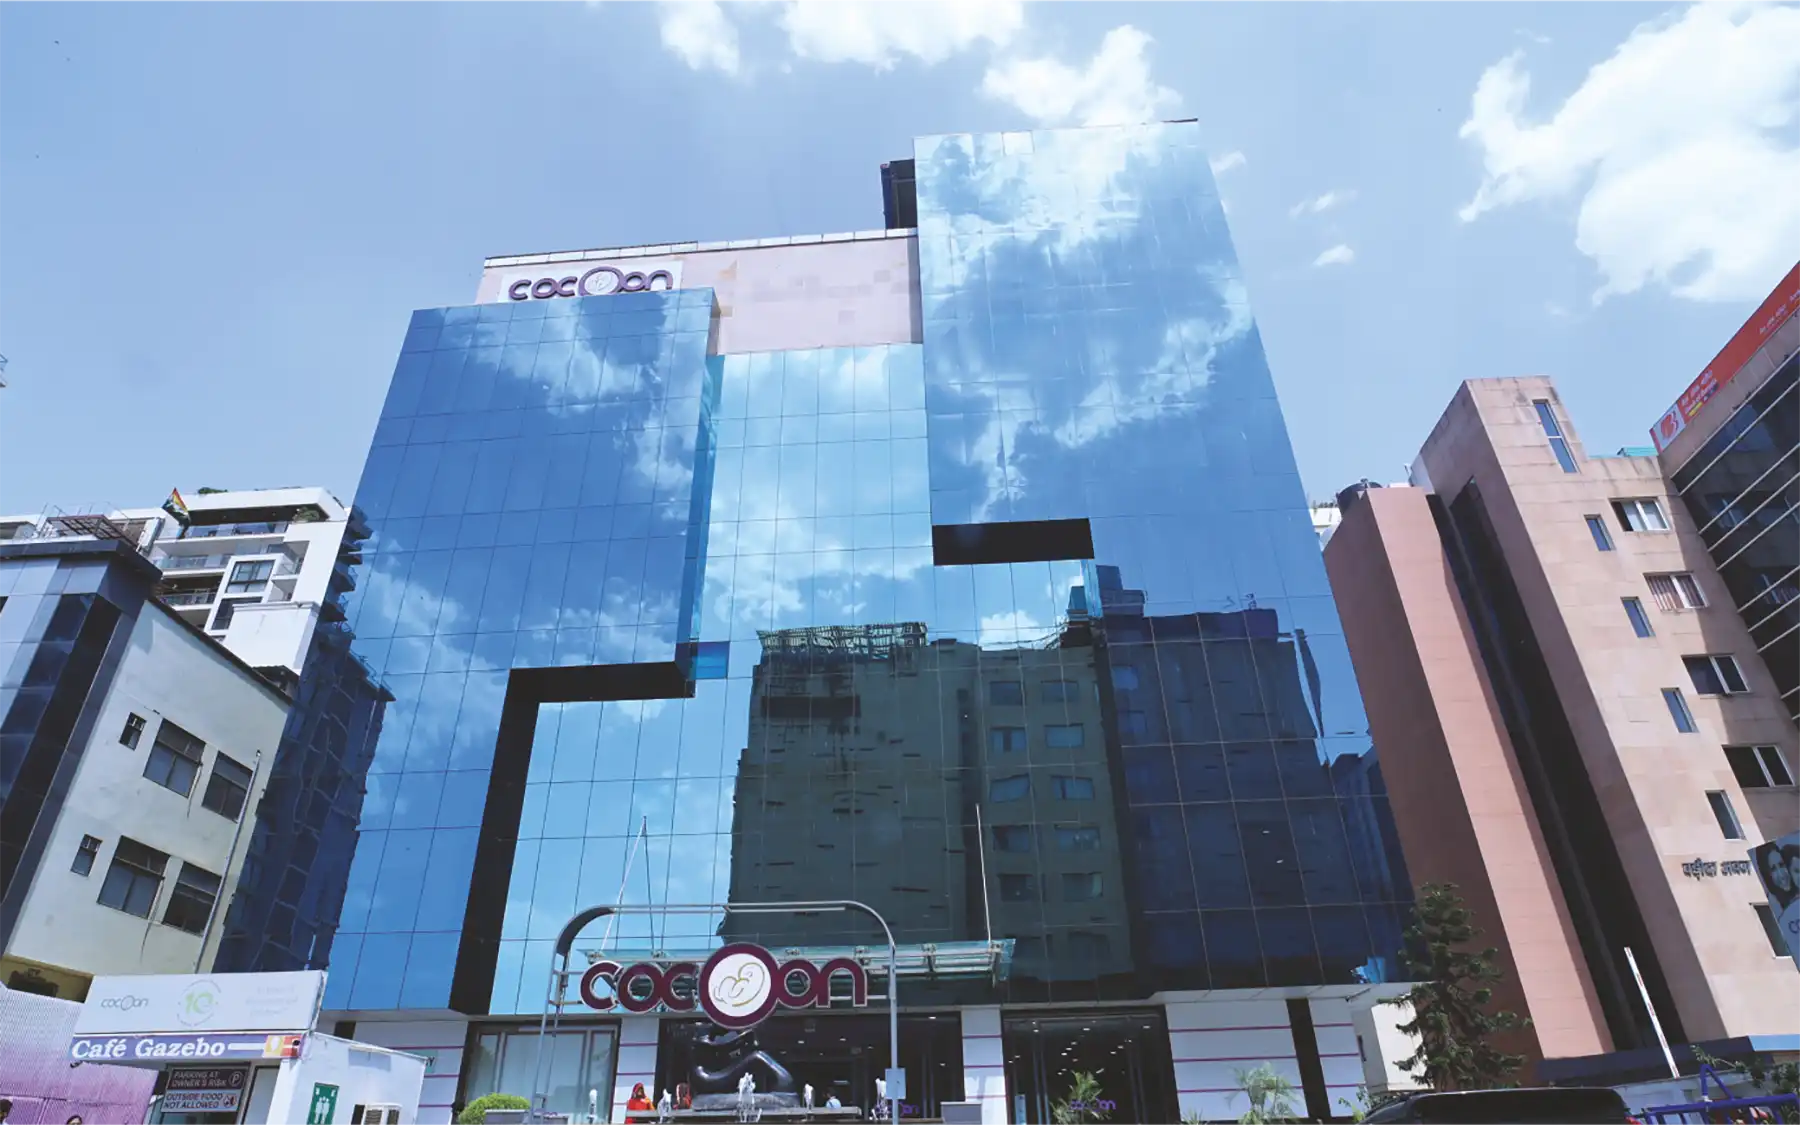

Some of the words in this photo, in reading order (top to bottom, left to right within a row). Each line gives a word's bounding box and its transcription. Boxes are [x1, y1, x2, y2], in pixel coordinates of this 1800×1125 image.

[72, 1038, 127, 1058] Café
[135, 1037, 226, 1057] Gazebo
[173, 1071, 208, 1079] PARKING
[208, 1079, 227, 1087] RISK
[166, 1093, 198, 1101] OUTSIDE
[200, 1092, 223, 1101] FOOD
[164, 1101, 180, 1109] NOT
[181, 1101, 220, 1109] ALLOWED
